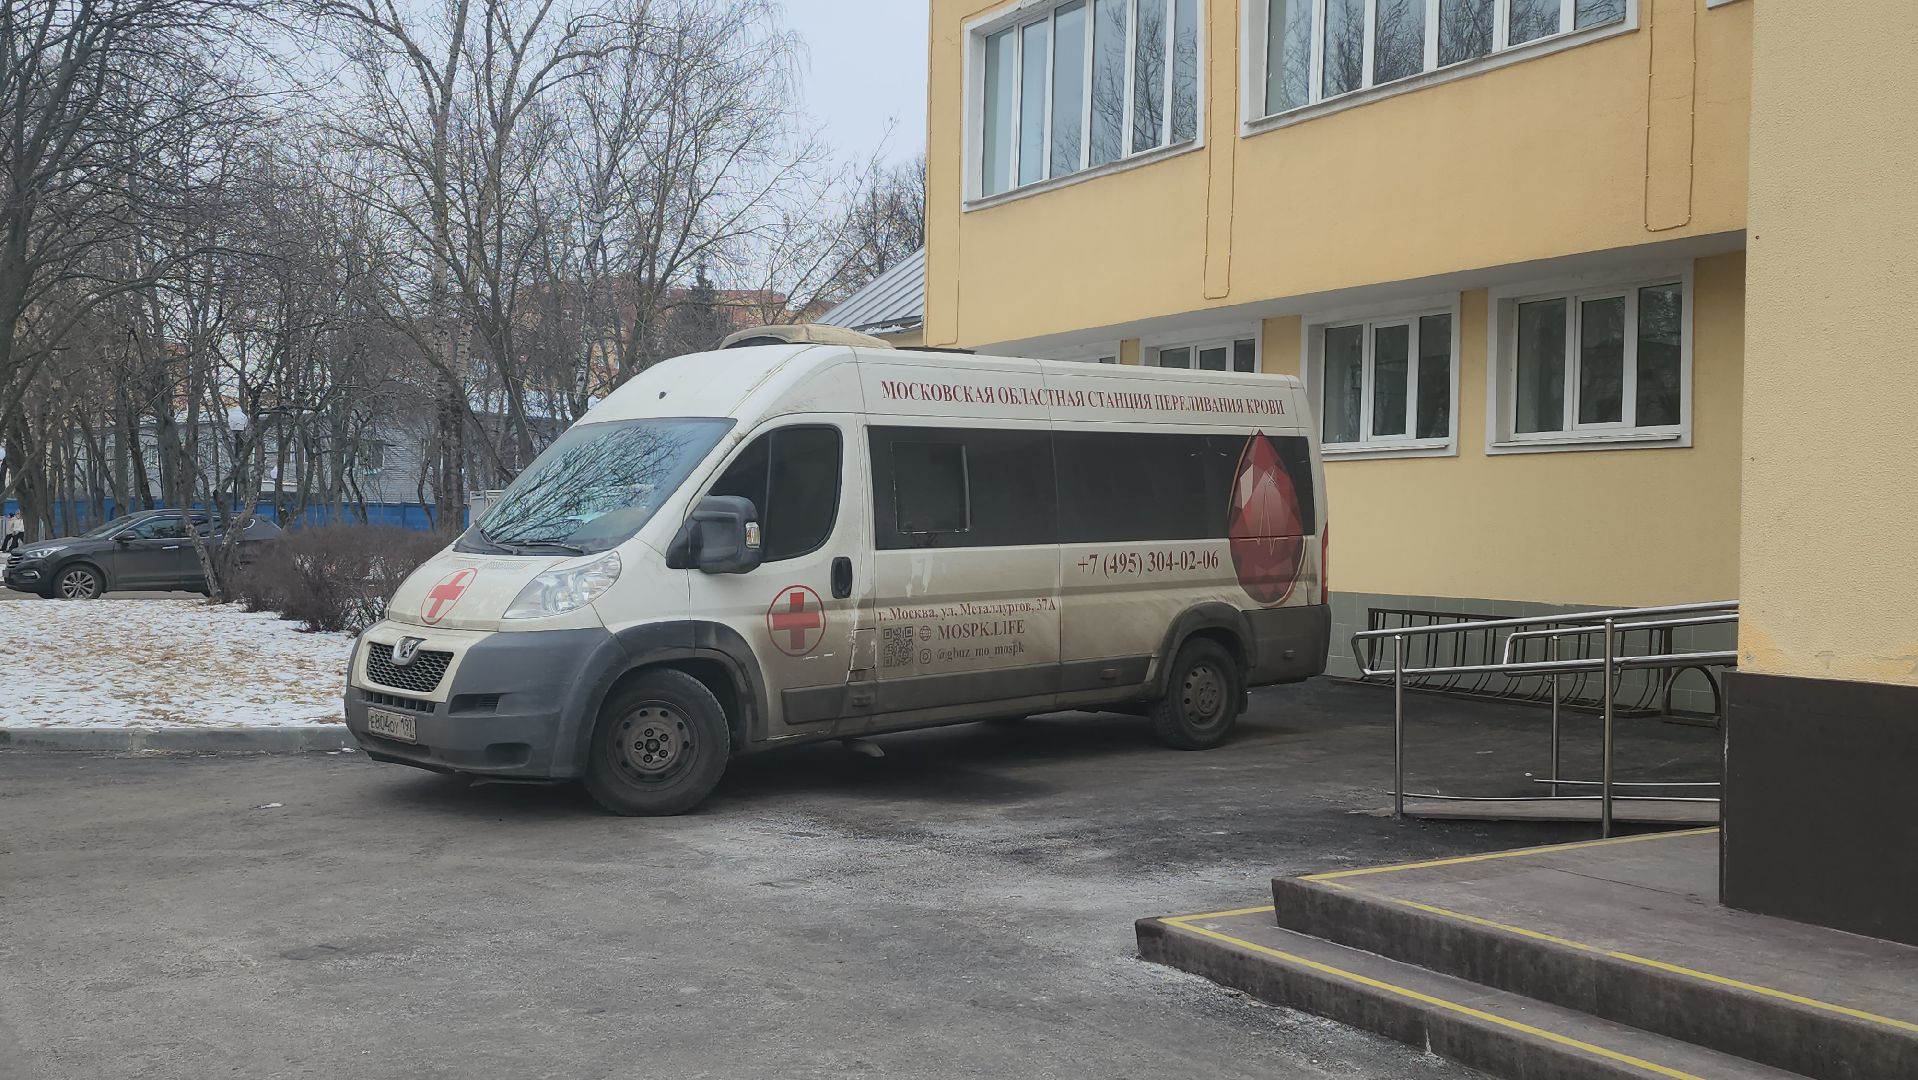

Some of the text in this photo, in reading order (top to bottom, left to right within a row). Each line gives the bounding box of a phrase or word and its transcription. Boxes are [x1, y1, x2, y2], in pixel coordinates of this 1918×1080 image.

[881, 380, 1285, 415] МОСКОВСКАЯ ОБЛАСТНАЯ СТАНЦИЯ ПЕРЕЛИВАНИЯ КРОВИ
[1077, 549, 1219, 580] +7 (495) 304-02-06
[889, 607, 939, 622] Москва,
[940, 607, 957, 621] ул.
[959, 601, 1035, 618] Металлургов,
[937, 619, 1025, 641] MOSPK.LIFE
